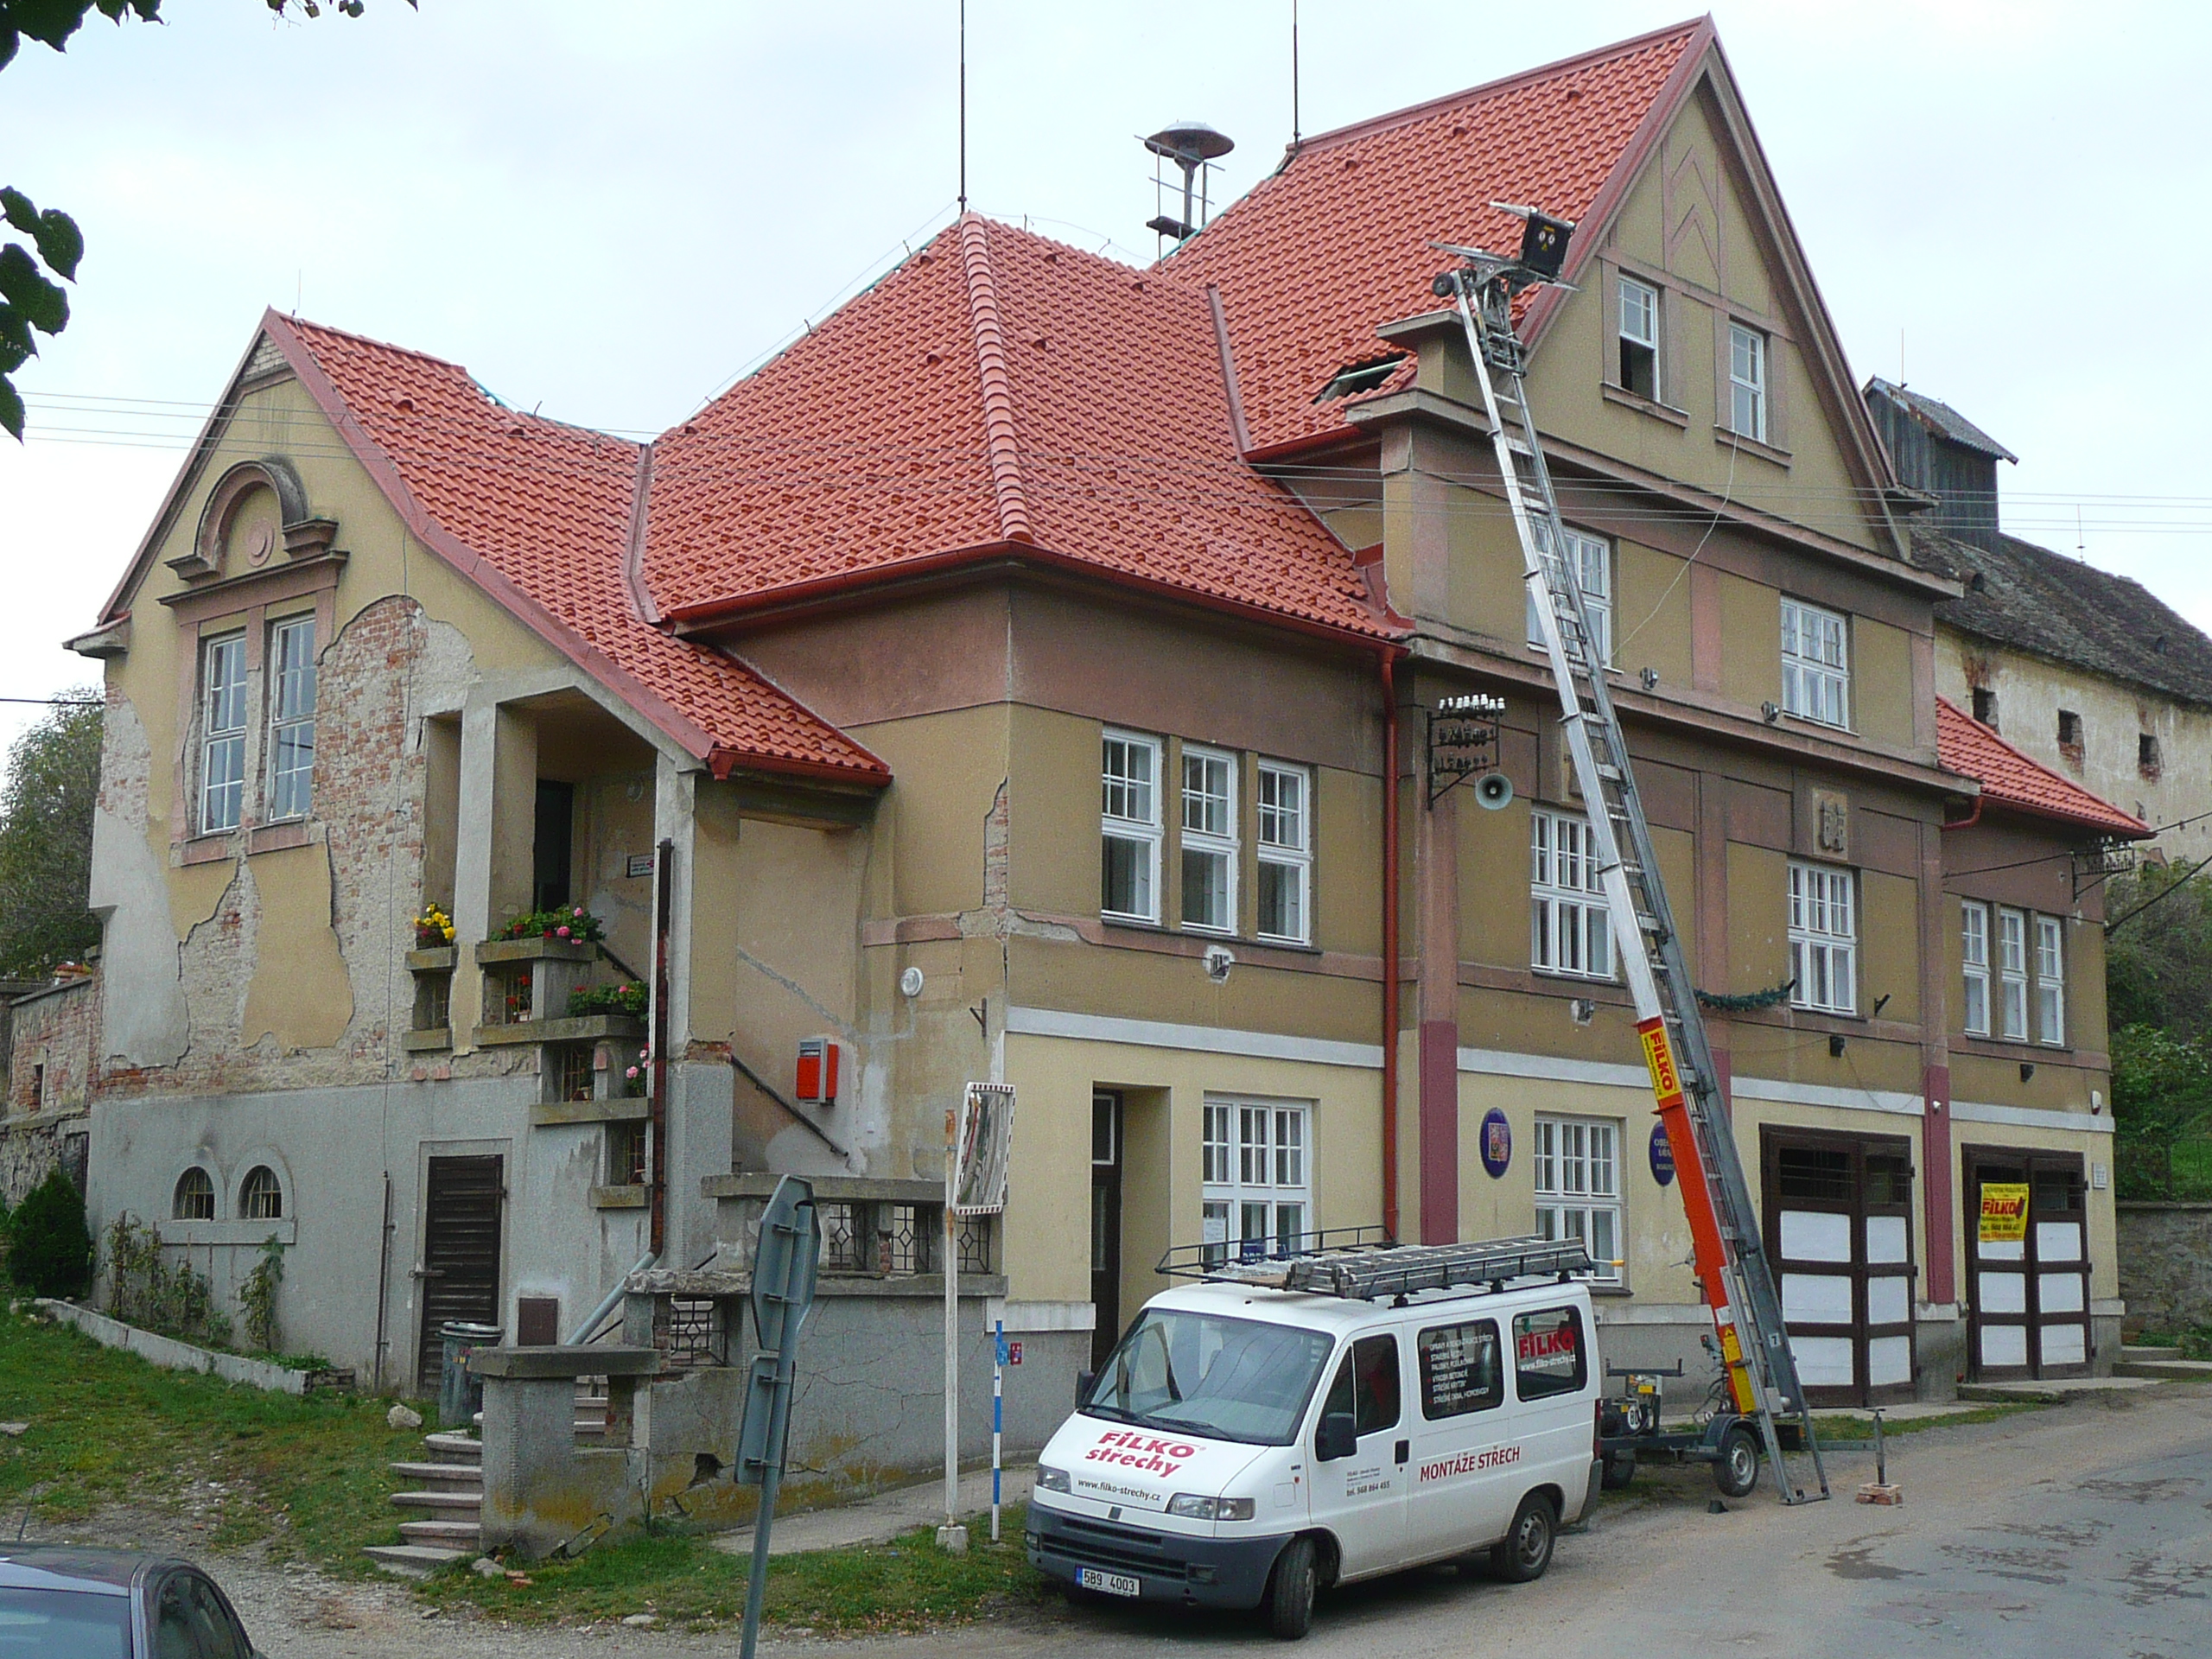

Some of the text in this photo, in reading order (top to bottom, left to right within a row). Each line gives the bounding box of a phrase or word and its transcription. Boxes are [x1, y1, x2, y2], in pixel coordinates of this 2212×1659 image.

[1085, 1447, 1182, 1478] střechy
[1421, 1446, 1520, 1482] MONTÁŽE STŘECH
[1078, 1479, 1161, 1501] www.filko-strechy.cz
[1084, 1571, 1135, 1592] 5B9 4003
